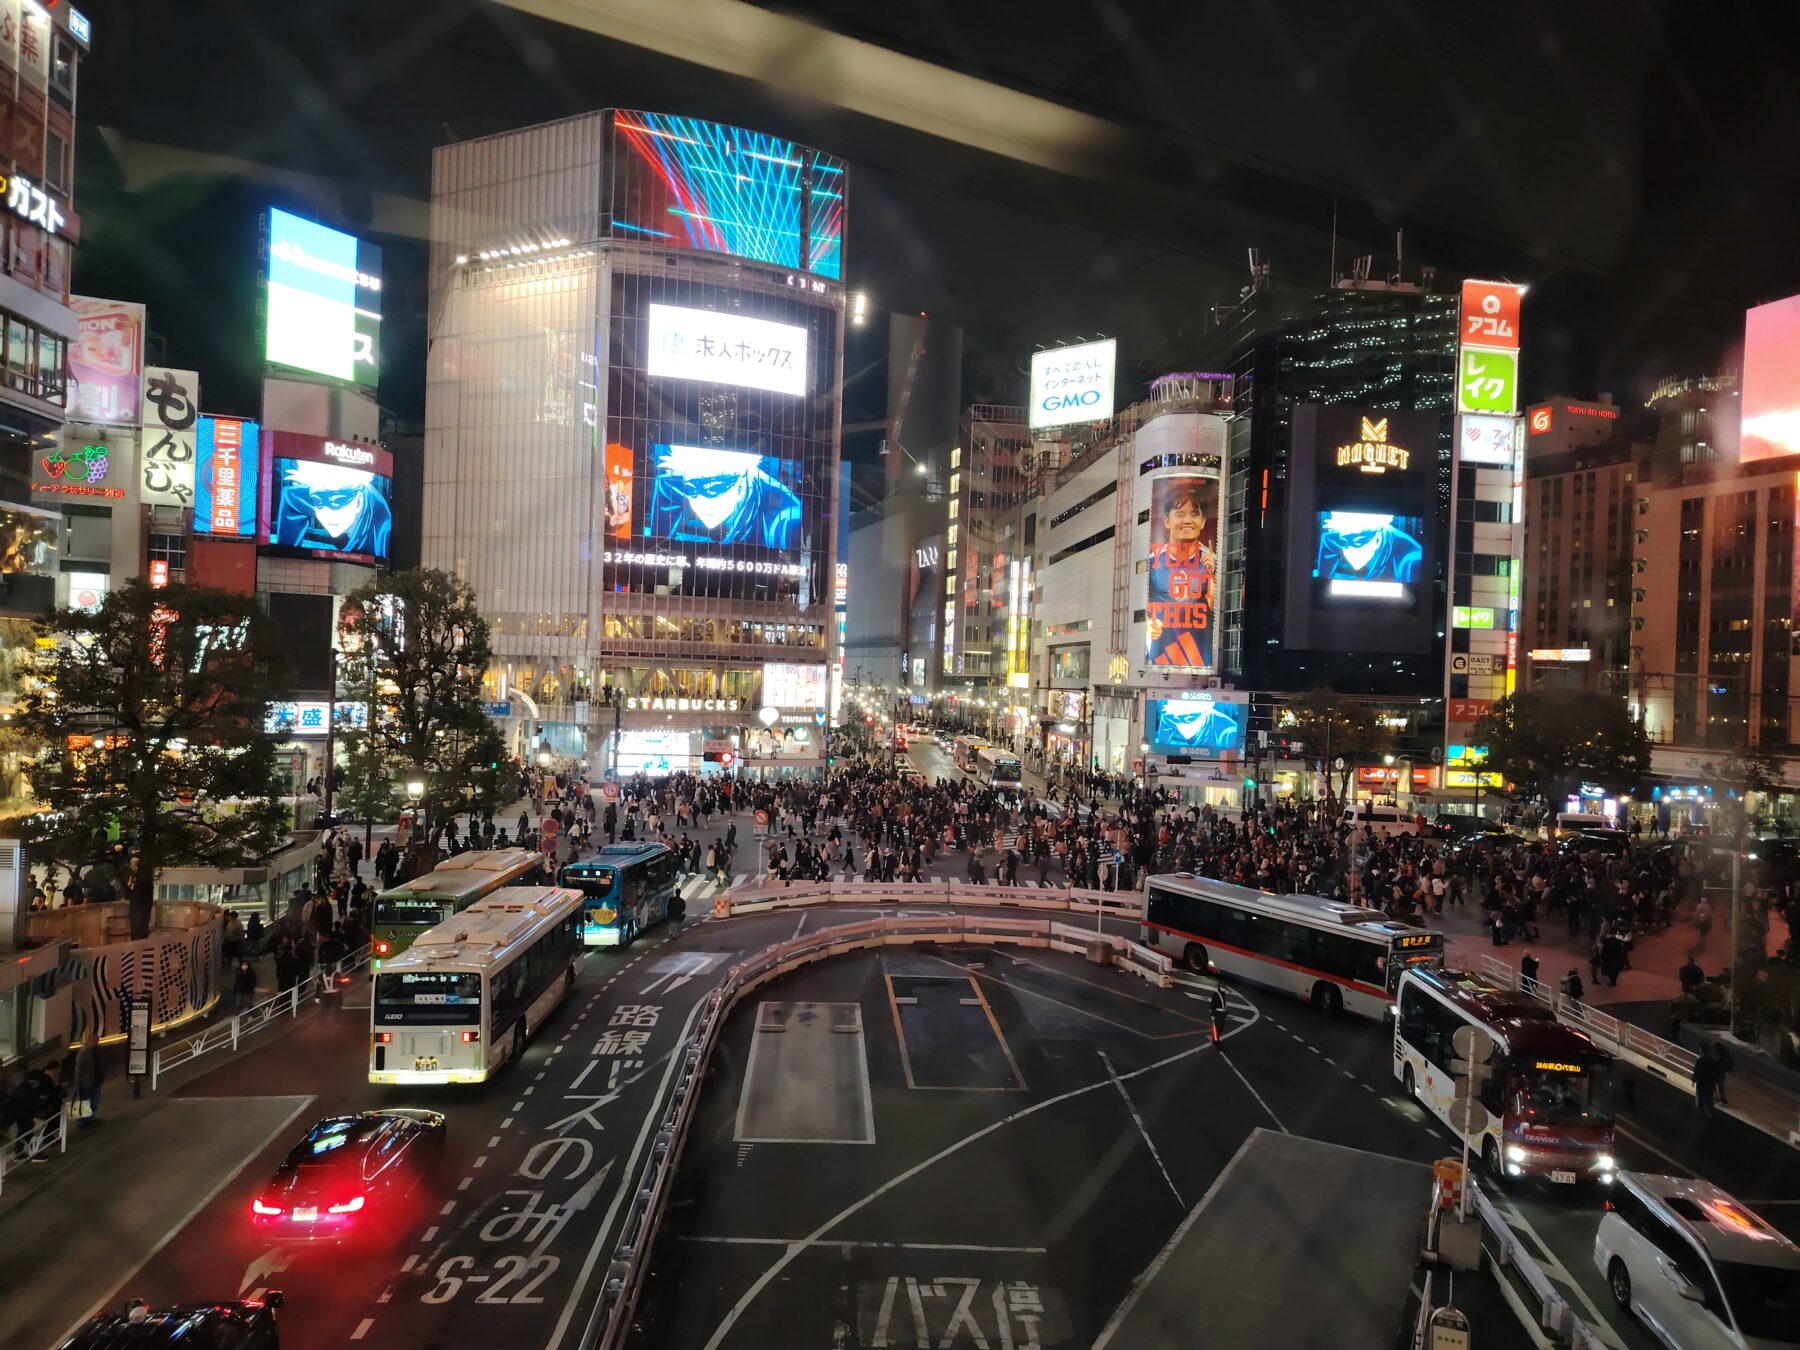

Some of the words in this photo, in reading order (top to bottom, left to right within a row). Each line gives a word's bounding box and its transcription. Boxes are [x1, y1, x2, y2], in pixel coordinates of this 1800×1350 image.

[8, 175, 64, 233] ガスト
[1468, 316, 1513, 337] アコム
[696, 334, 793, 369] 求人ボックス
[1043, 371, 1102, 390] インターネット
[1042, 390, 1101, 411] GMO
[1567, 405, 1586, 415] TOKYU
[1587, 408, 1597, 416] REI
[1598, 411, 1616, 419] HOTEL
[145, 371, 196, 504] もんじゃ
[325, 441, 374, 464] Rakuten
[1337, 442, 1409, 470] MAGNET
[215, 424, 237, 527] 三千里薬品
[1149, 543, 1200, 569] YOU
[1168, 573, 1216, 600] GOT
[1149, 602, 1208, 629] THIS
[1459, 610, 1492, 624] レイク
[627, 697, 738, 710] STARBUCKS
[781, 715, 813, 723] TSUTAYA
[384, 1013, 404, 1021] KEIO
[421, 1255, 561, 1304] S-22
[870, 1276, 1044, 1350] バス停
